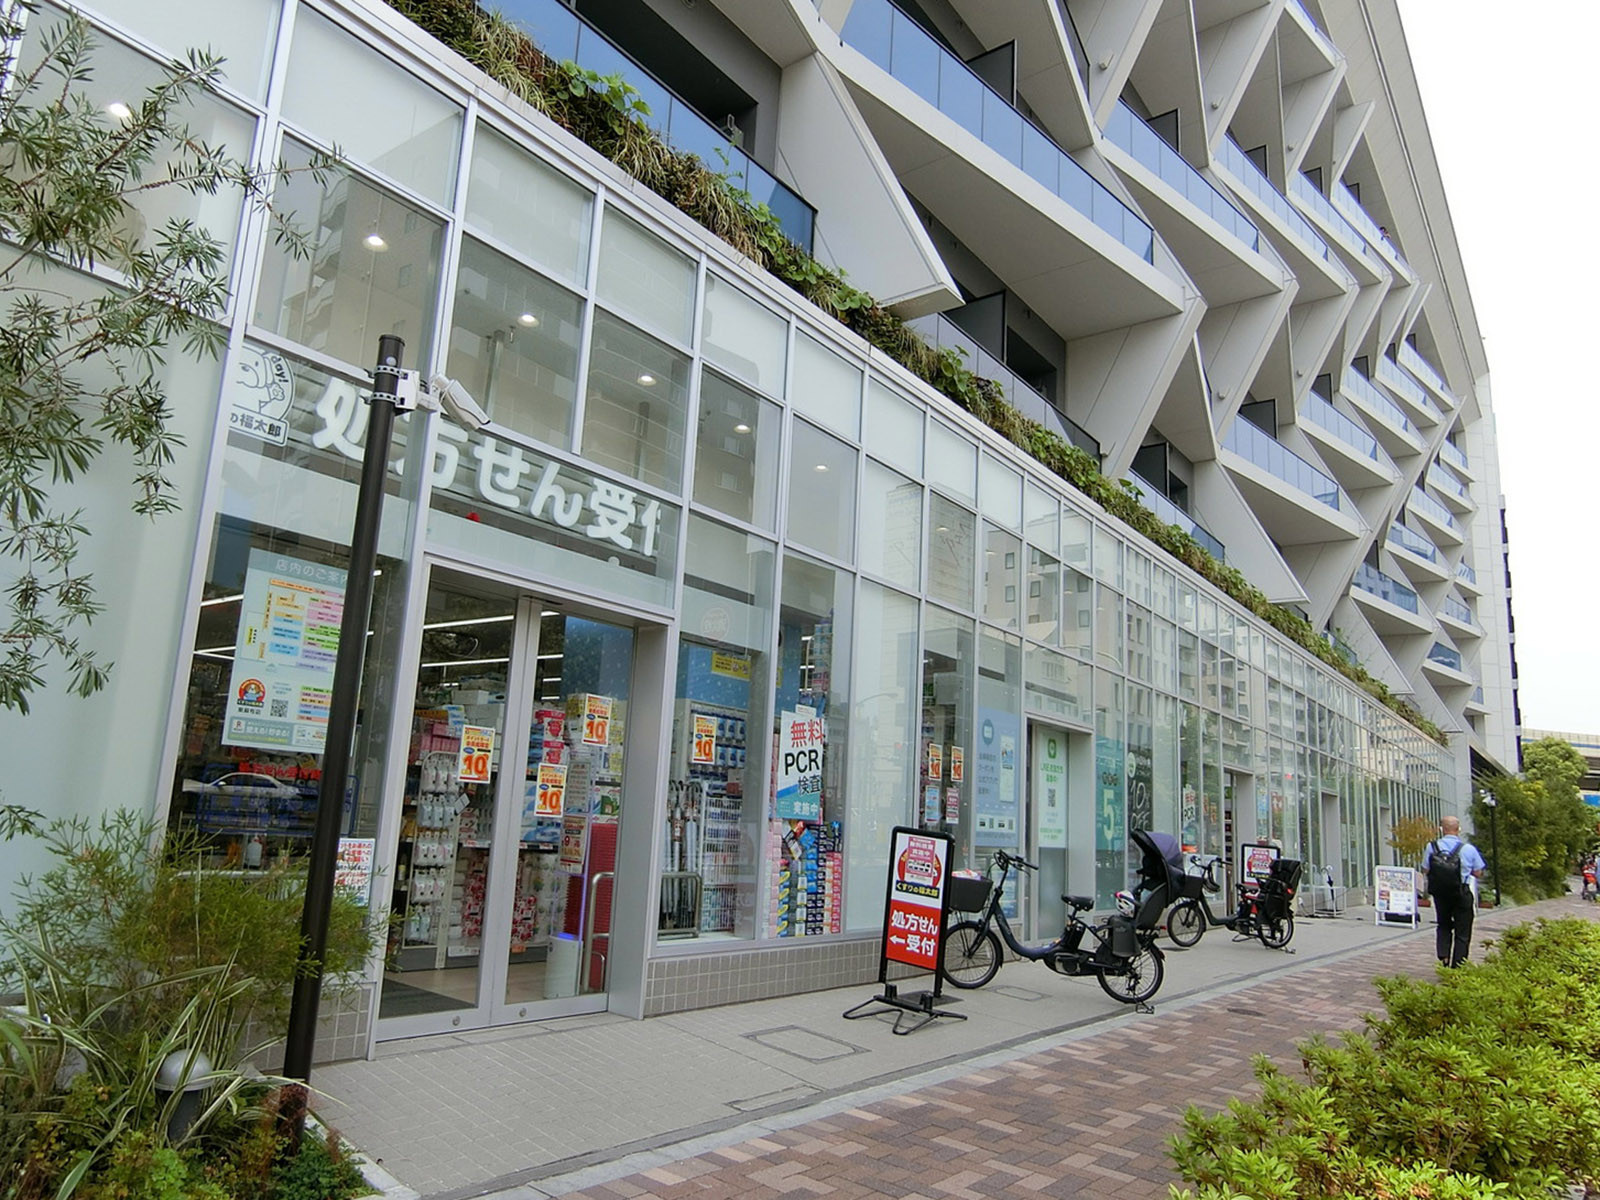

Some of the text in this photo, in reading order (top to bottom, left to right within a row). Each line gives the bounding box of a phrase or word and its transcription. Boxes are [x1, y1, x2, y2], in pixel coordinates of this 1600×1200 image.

[270, 355, 289, 383] day!
[791, 719, 826, 748] 無料
[784, 749, 820, 776] PCR
[896, 883, 939, 897] くすりの福太郎
[891, 909, 938, 936] 処方せん
[905, 933, 936, 957] 受付
